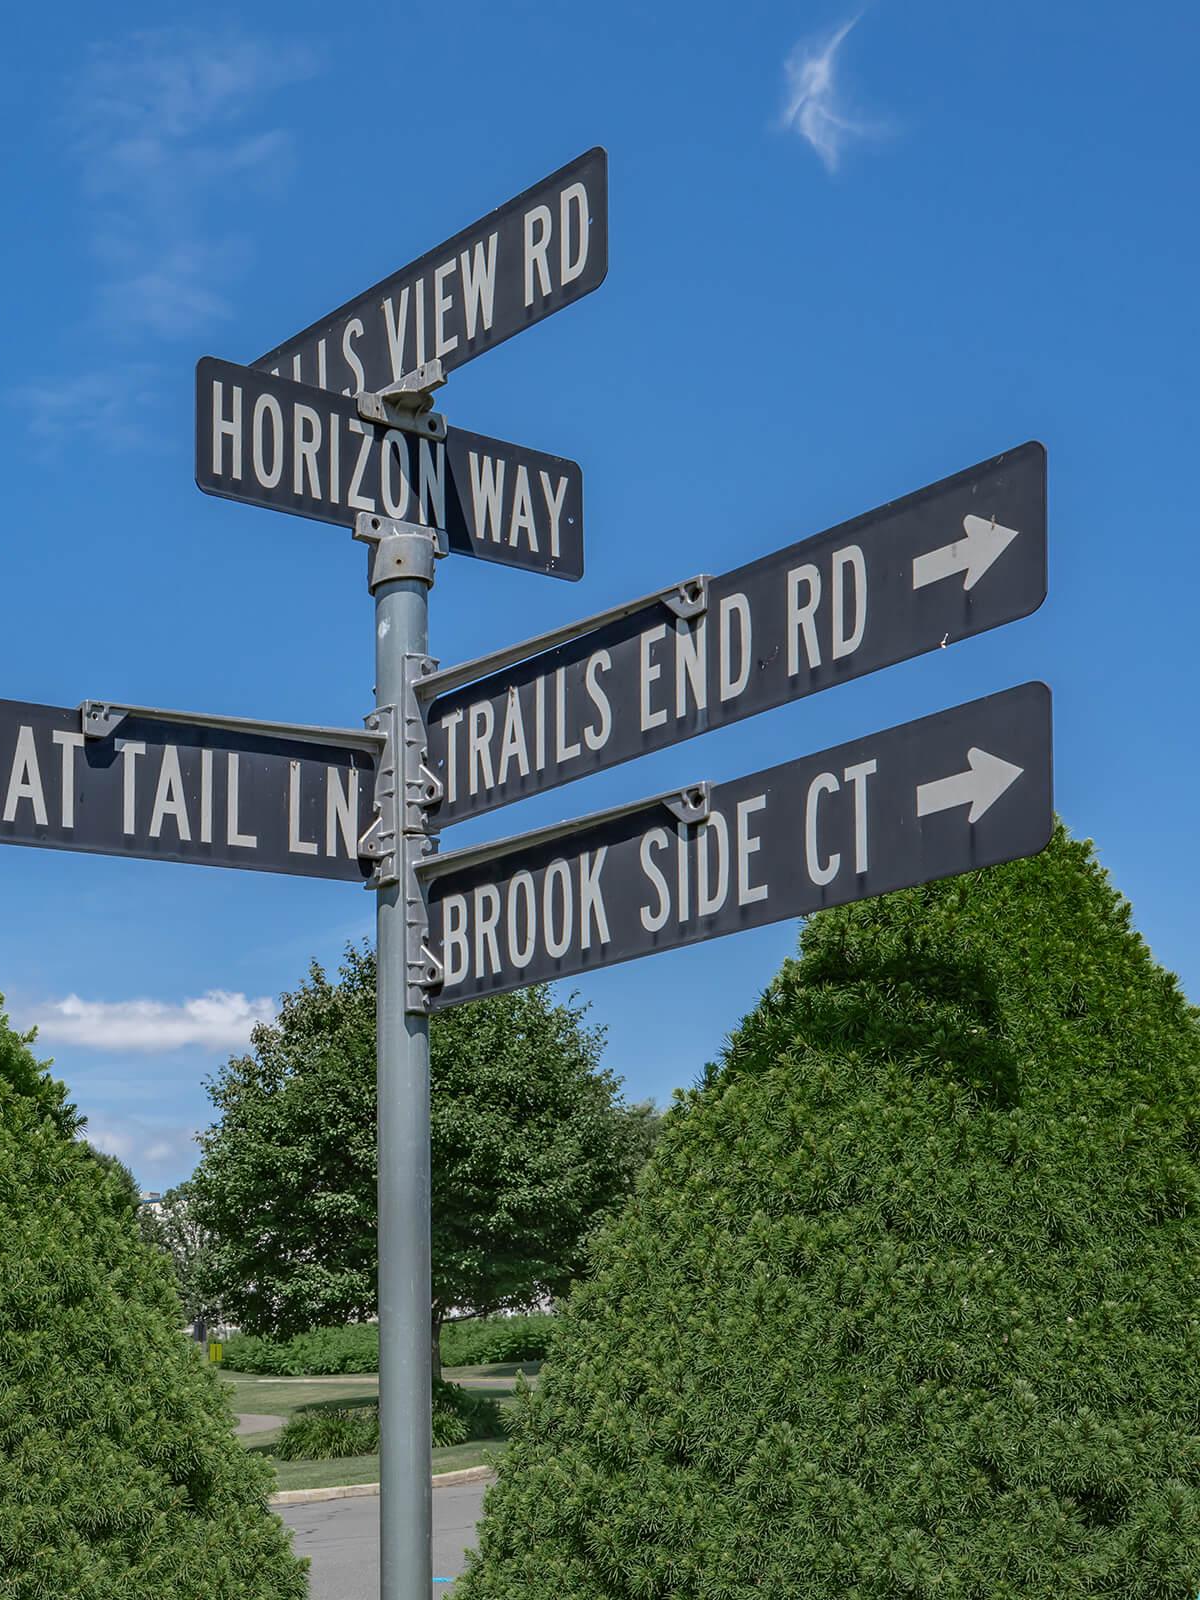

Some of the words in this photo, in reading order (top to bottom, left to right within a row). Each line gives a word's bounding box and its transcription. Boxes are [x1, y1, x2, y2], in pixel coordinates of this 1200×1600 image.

[384, 232, 498, 384] VIEW
[524, 182, 590, 307] RD
[212, 380, 446, 530] HORIZON
[469, 452, 568, 558] WAY
[441, 650, 612, 803] TRAILS
[640, 592, 752, 731] END
[787, 544, 868, 677] RD
[114, 739, 257, 848] TAIL
[289, 761, 359, 860] LN
[442, 844, 610, 987] BROOK
[639, 794, 769, 933] SIDE
[805, 758, 877, 886] CT
